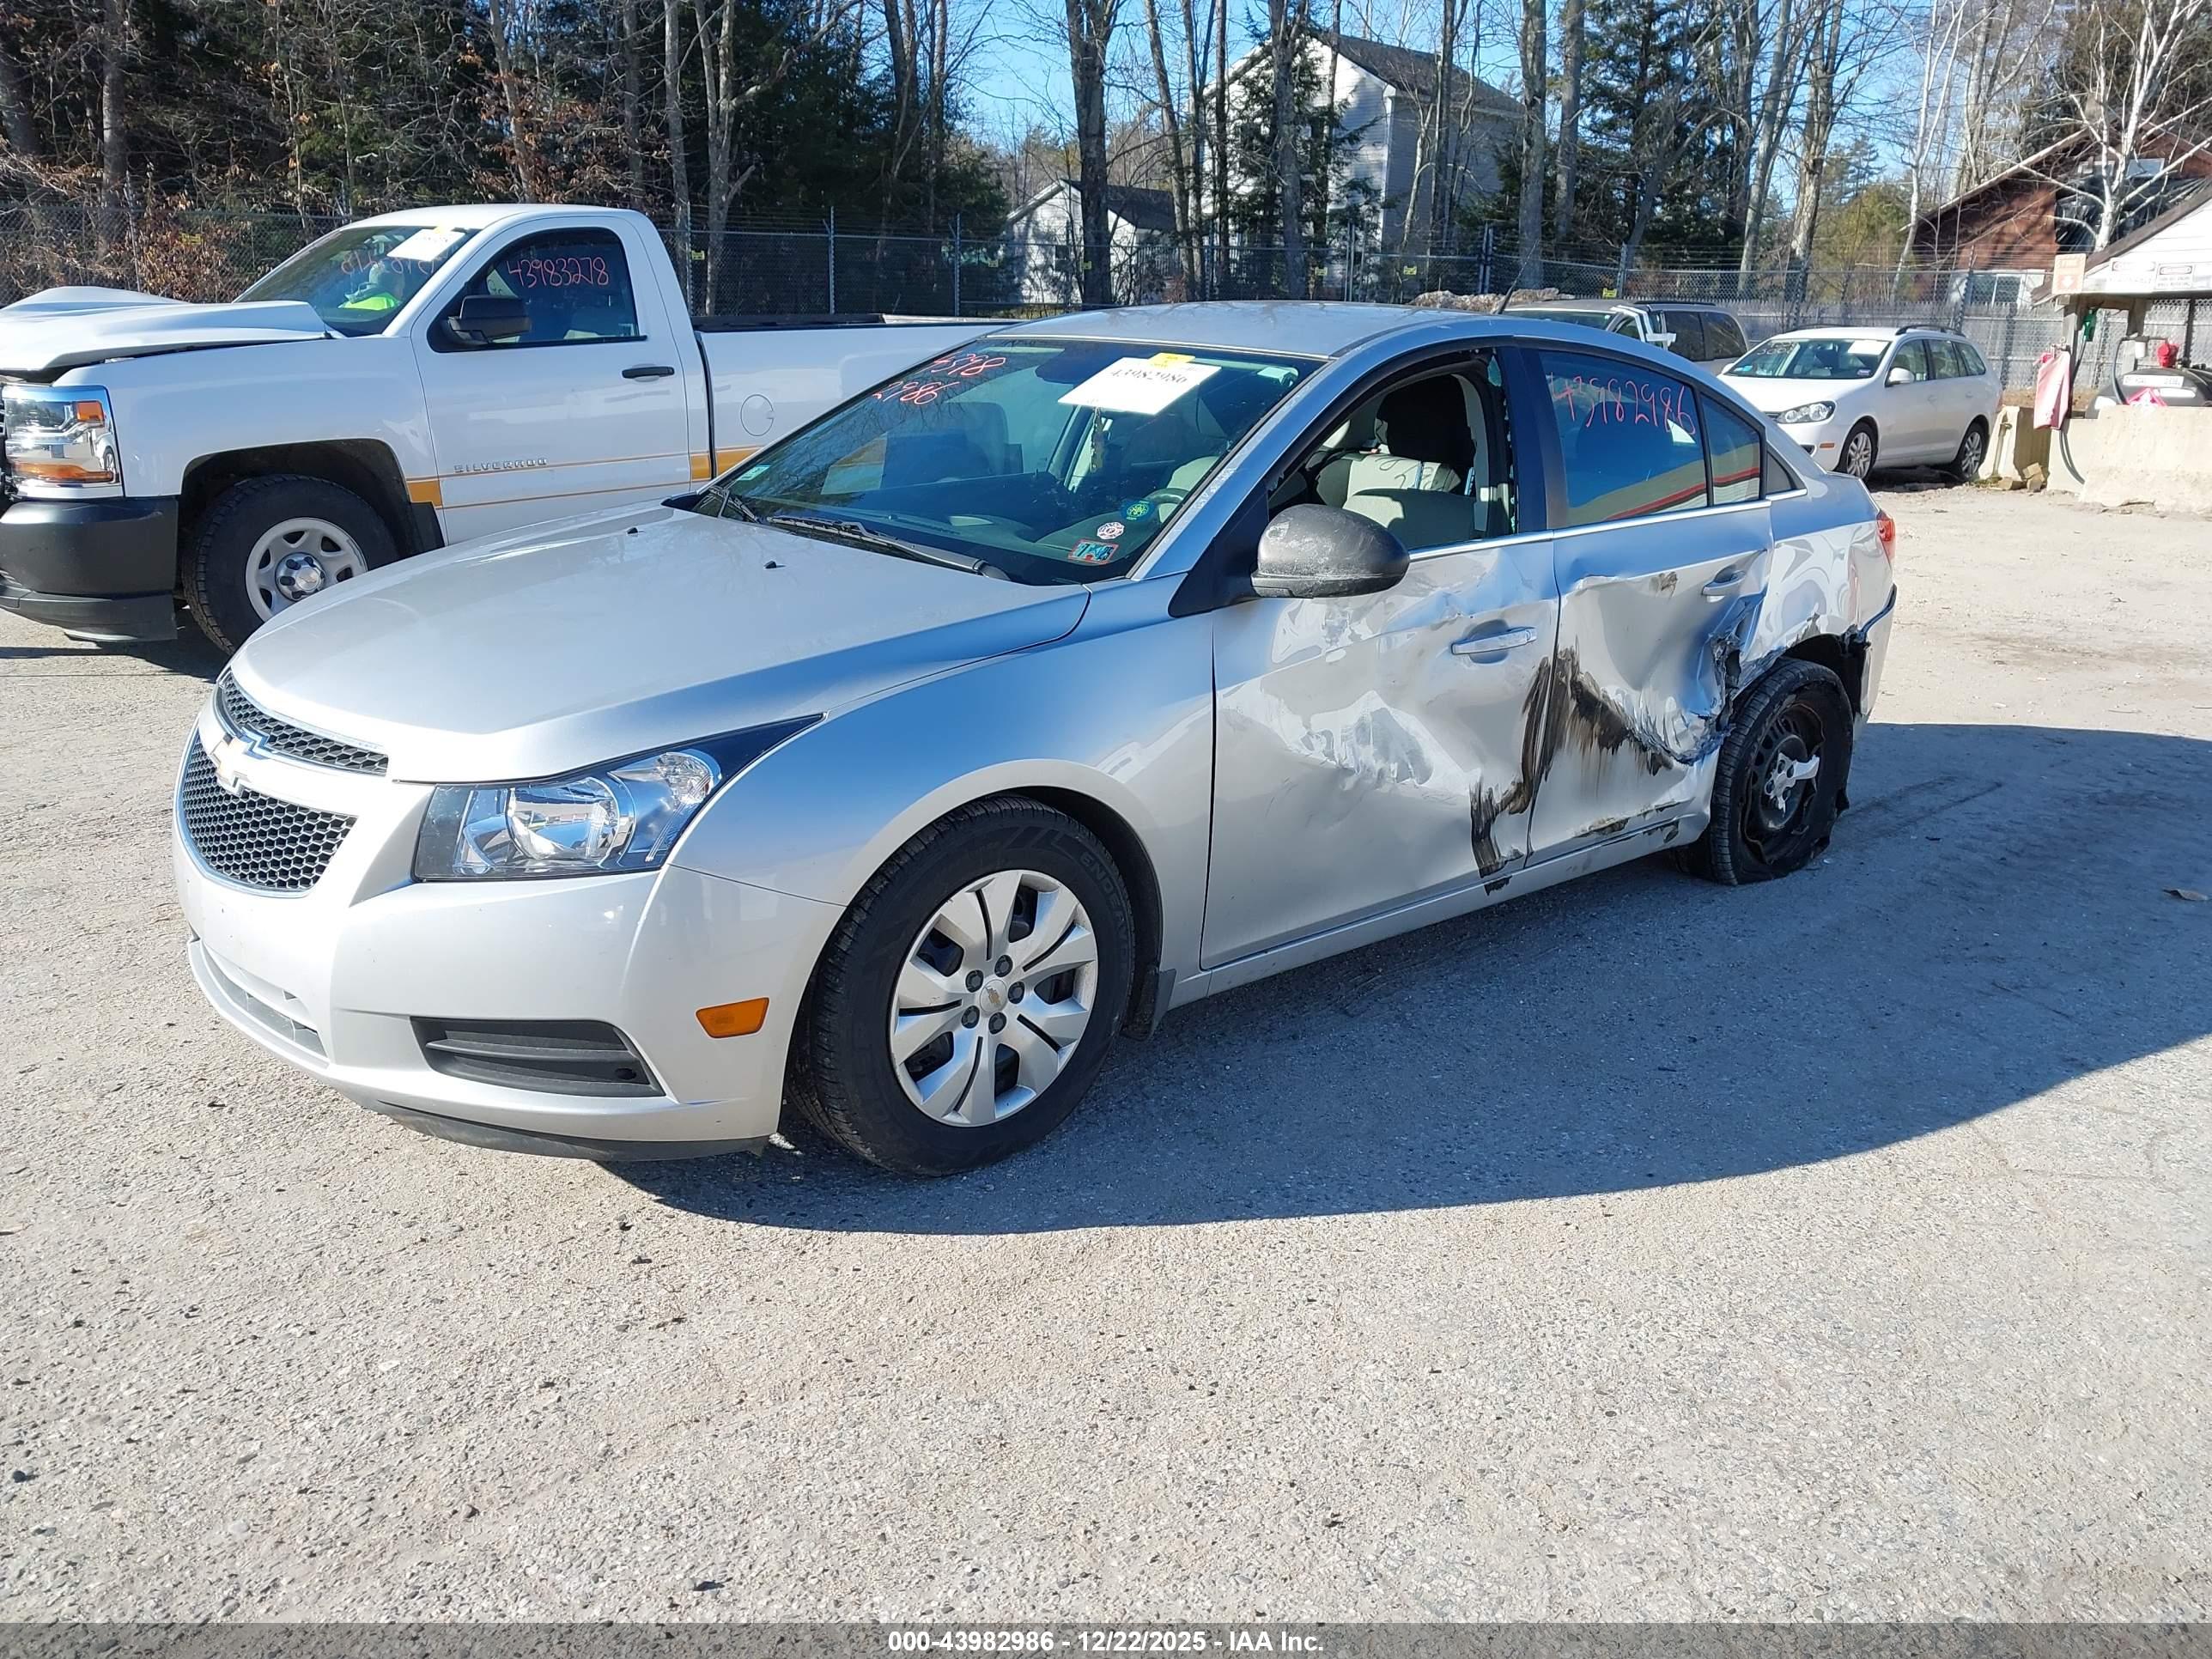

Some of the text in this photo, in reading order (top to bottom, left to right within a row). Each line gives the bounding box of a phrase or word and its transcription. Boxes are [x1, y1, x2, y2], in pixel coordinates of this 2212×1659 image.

[506, 257, 609, 288] 43983278
[1550, 371, 1696, 434] 43982986
[453, 457, 548, 473] SILVERADO
